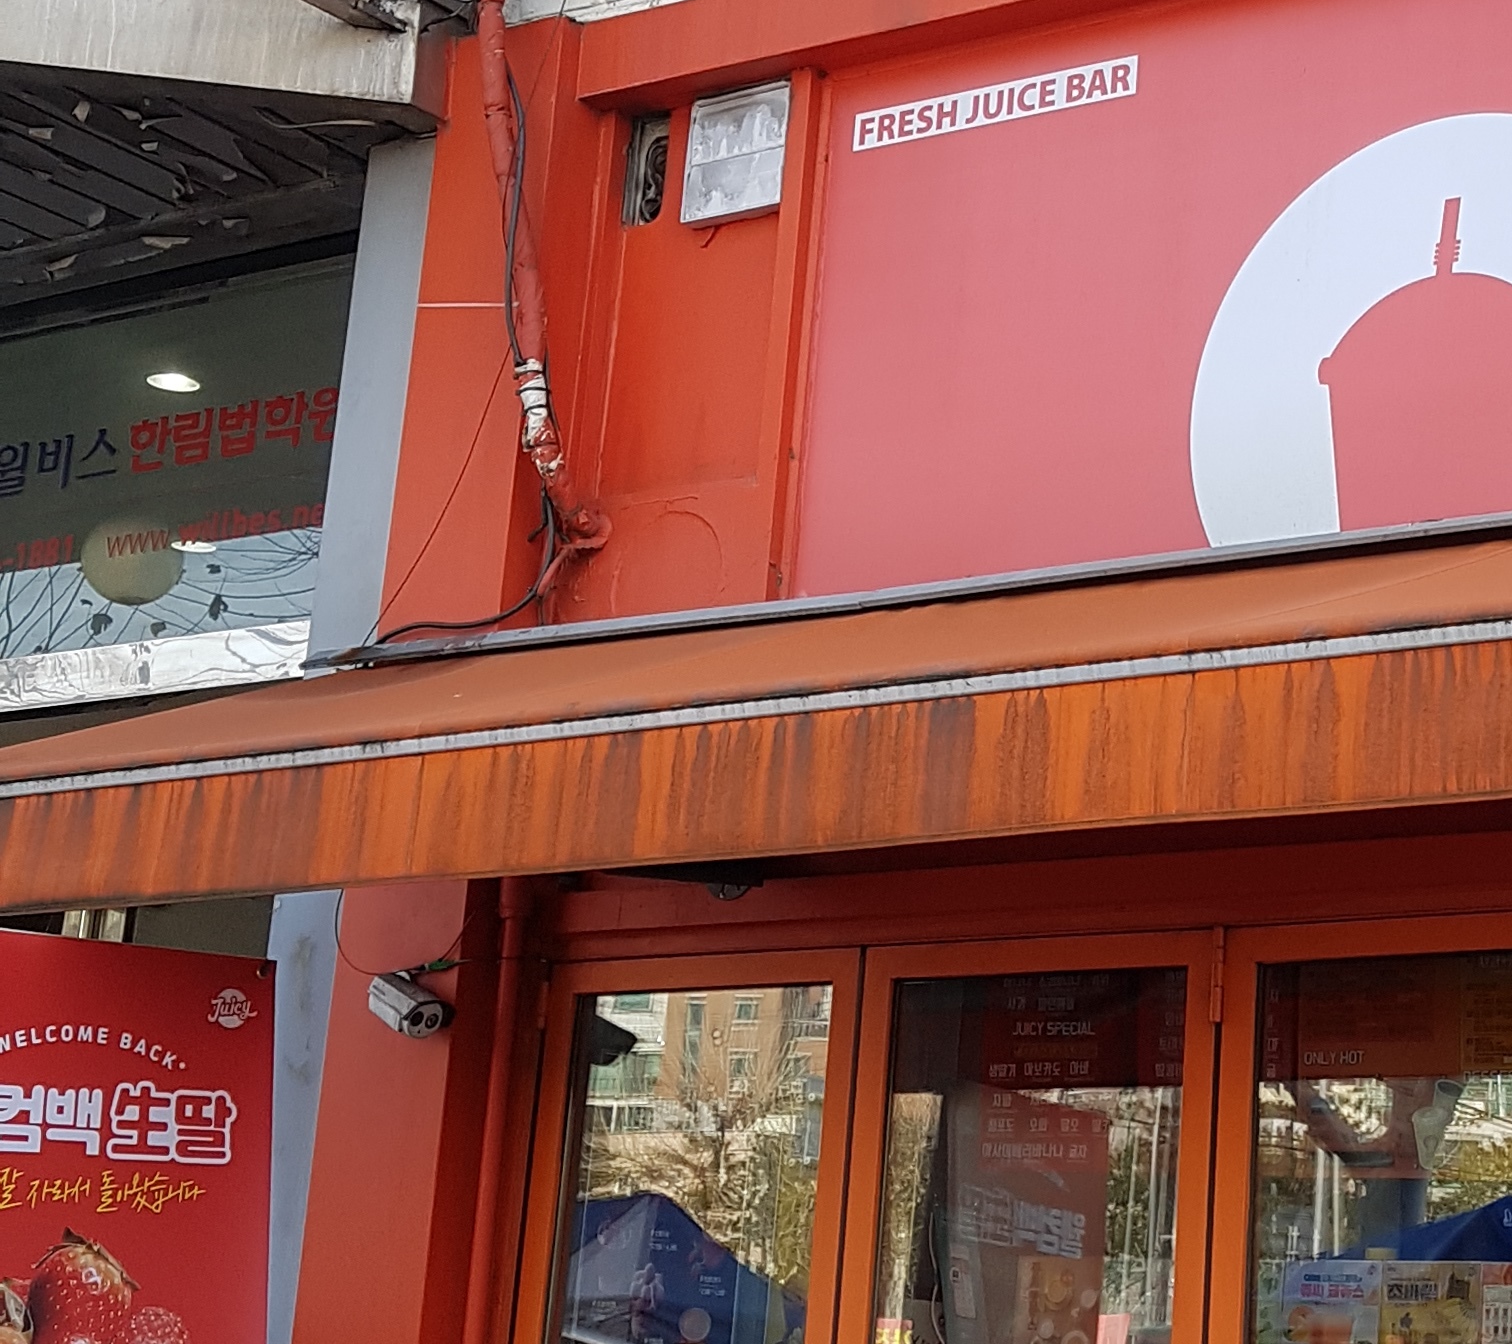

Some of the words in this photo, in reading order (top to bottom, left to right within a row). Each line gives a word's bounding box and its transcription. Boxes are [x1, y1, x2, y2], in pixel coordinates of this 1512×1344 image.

[857, 98, 959, 147] FRESH
[964, 78, 1057, 125] JUICE
[1064, 63, 1132, 104] BAR
[207, 998, 258, 1024] Juicy
[1012, 1021, 1044, 1036] JUICY
[1045, 1020, 1096, 1036] SPECIAL
[1303, 1051, 1337, 1066] ONLY
[1339, 1050, 1365, 1064] HOT
